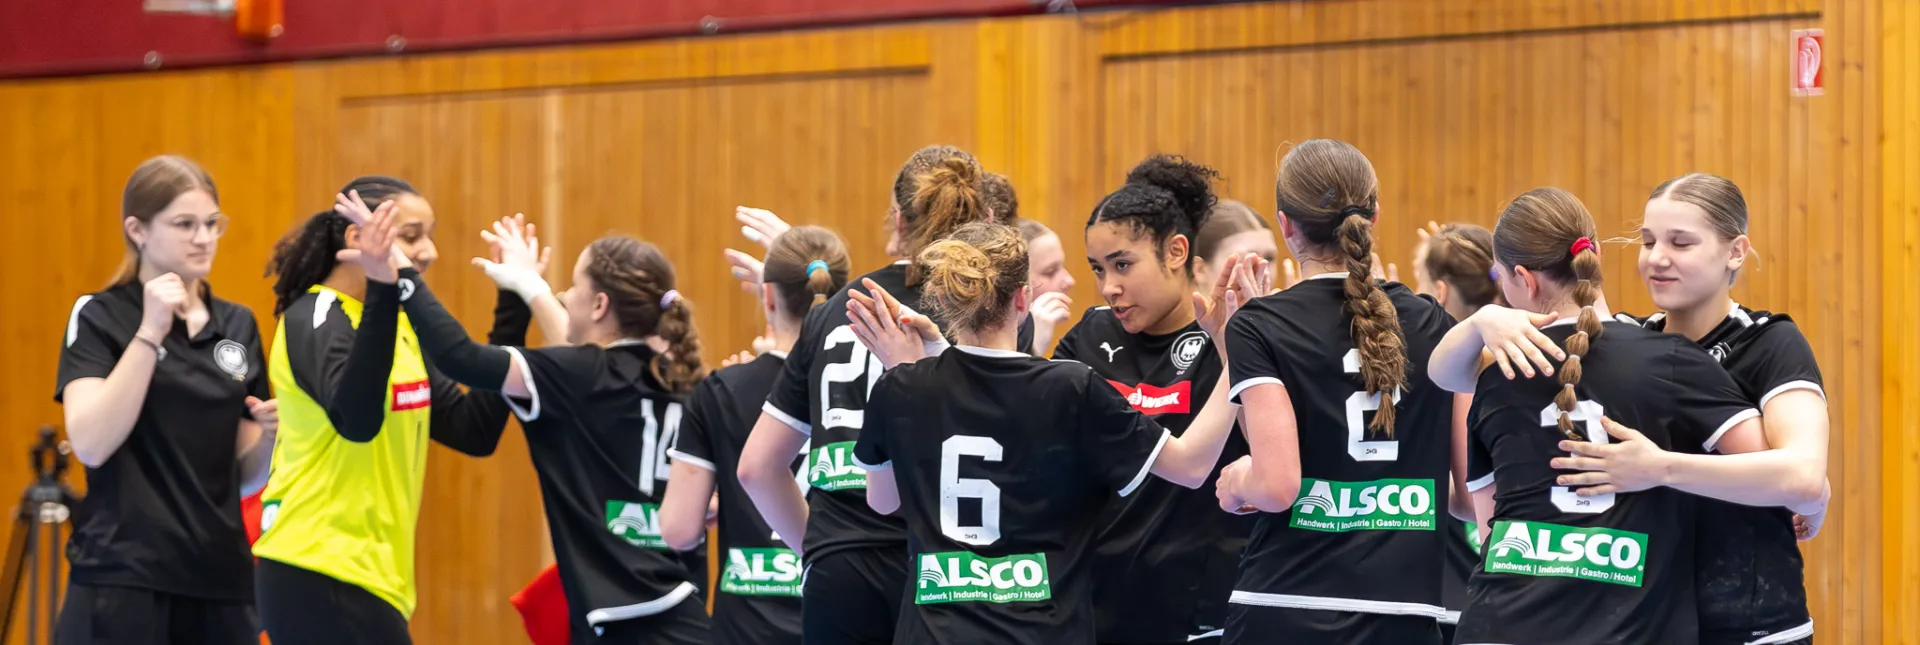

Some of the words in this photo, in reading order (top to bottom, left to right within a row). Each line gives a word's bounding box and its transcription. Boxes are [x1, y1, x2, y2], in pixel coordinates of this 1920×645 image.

[820, 324, 884, 430] 2
[1342, 348, 1401, 461] 2
[940, 434, 1003, 546] 6
[1293, 480, 1430, 517] ALSCO
[1297, 518, 1335, 529] Handwerk
[1341, 519, 1370, 529] Industrie
[1376, 518, 1401, 527] Gastro
[1408, 519, 1430, 527] Hotel
[1489, 522, 1641, 569] ALSCO
[727, 548, 803, 581] ALS
[918, 554, 1043, 589] ALSCO
[1493, 562, 1531, 572] Handwerk
[1538, 565, 1574, 574] Industrie
[1581, 568, 1609, 579] Gastro
[1614, 572, 1636, 583] Hotel
[953, 590, 988, 599] Industrie
[993, 591, 1018, 600] Gastro
[1024, 590, 1045, 599] Hotel
